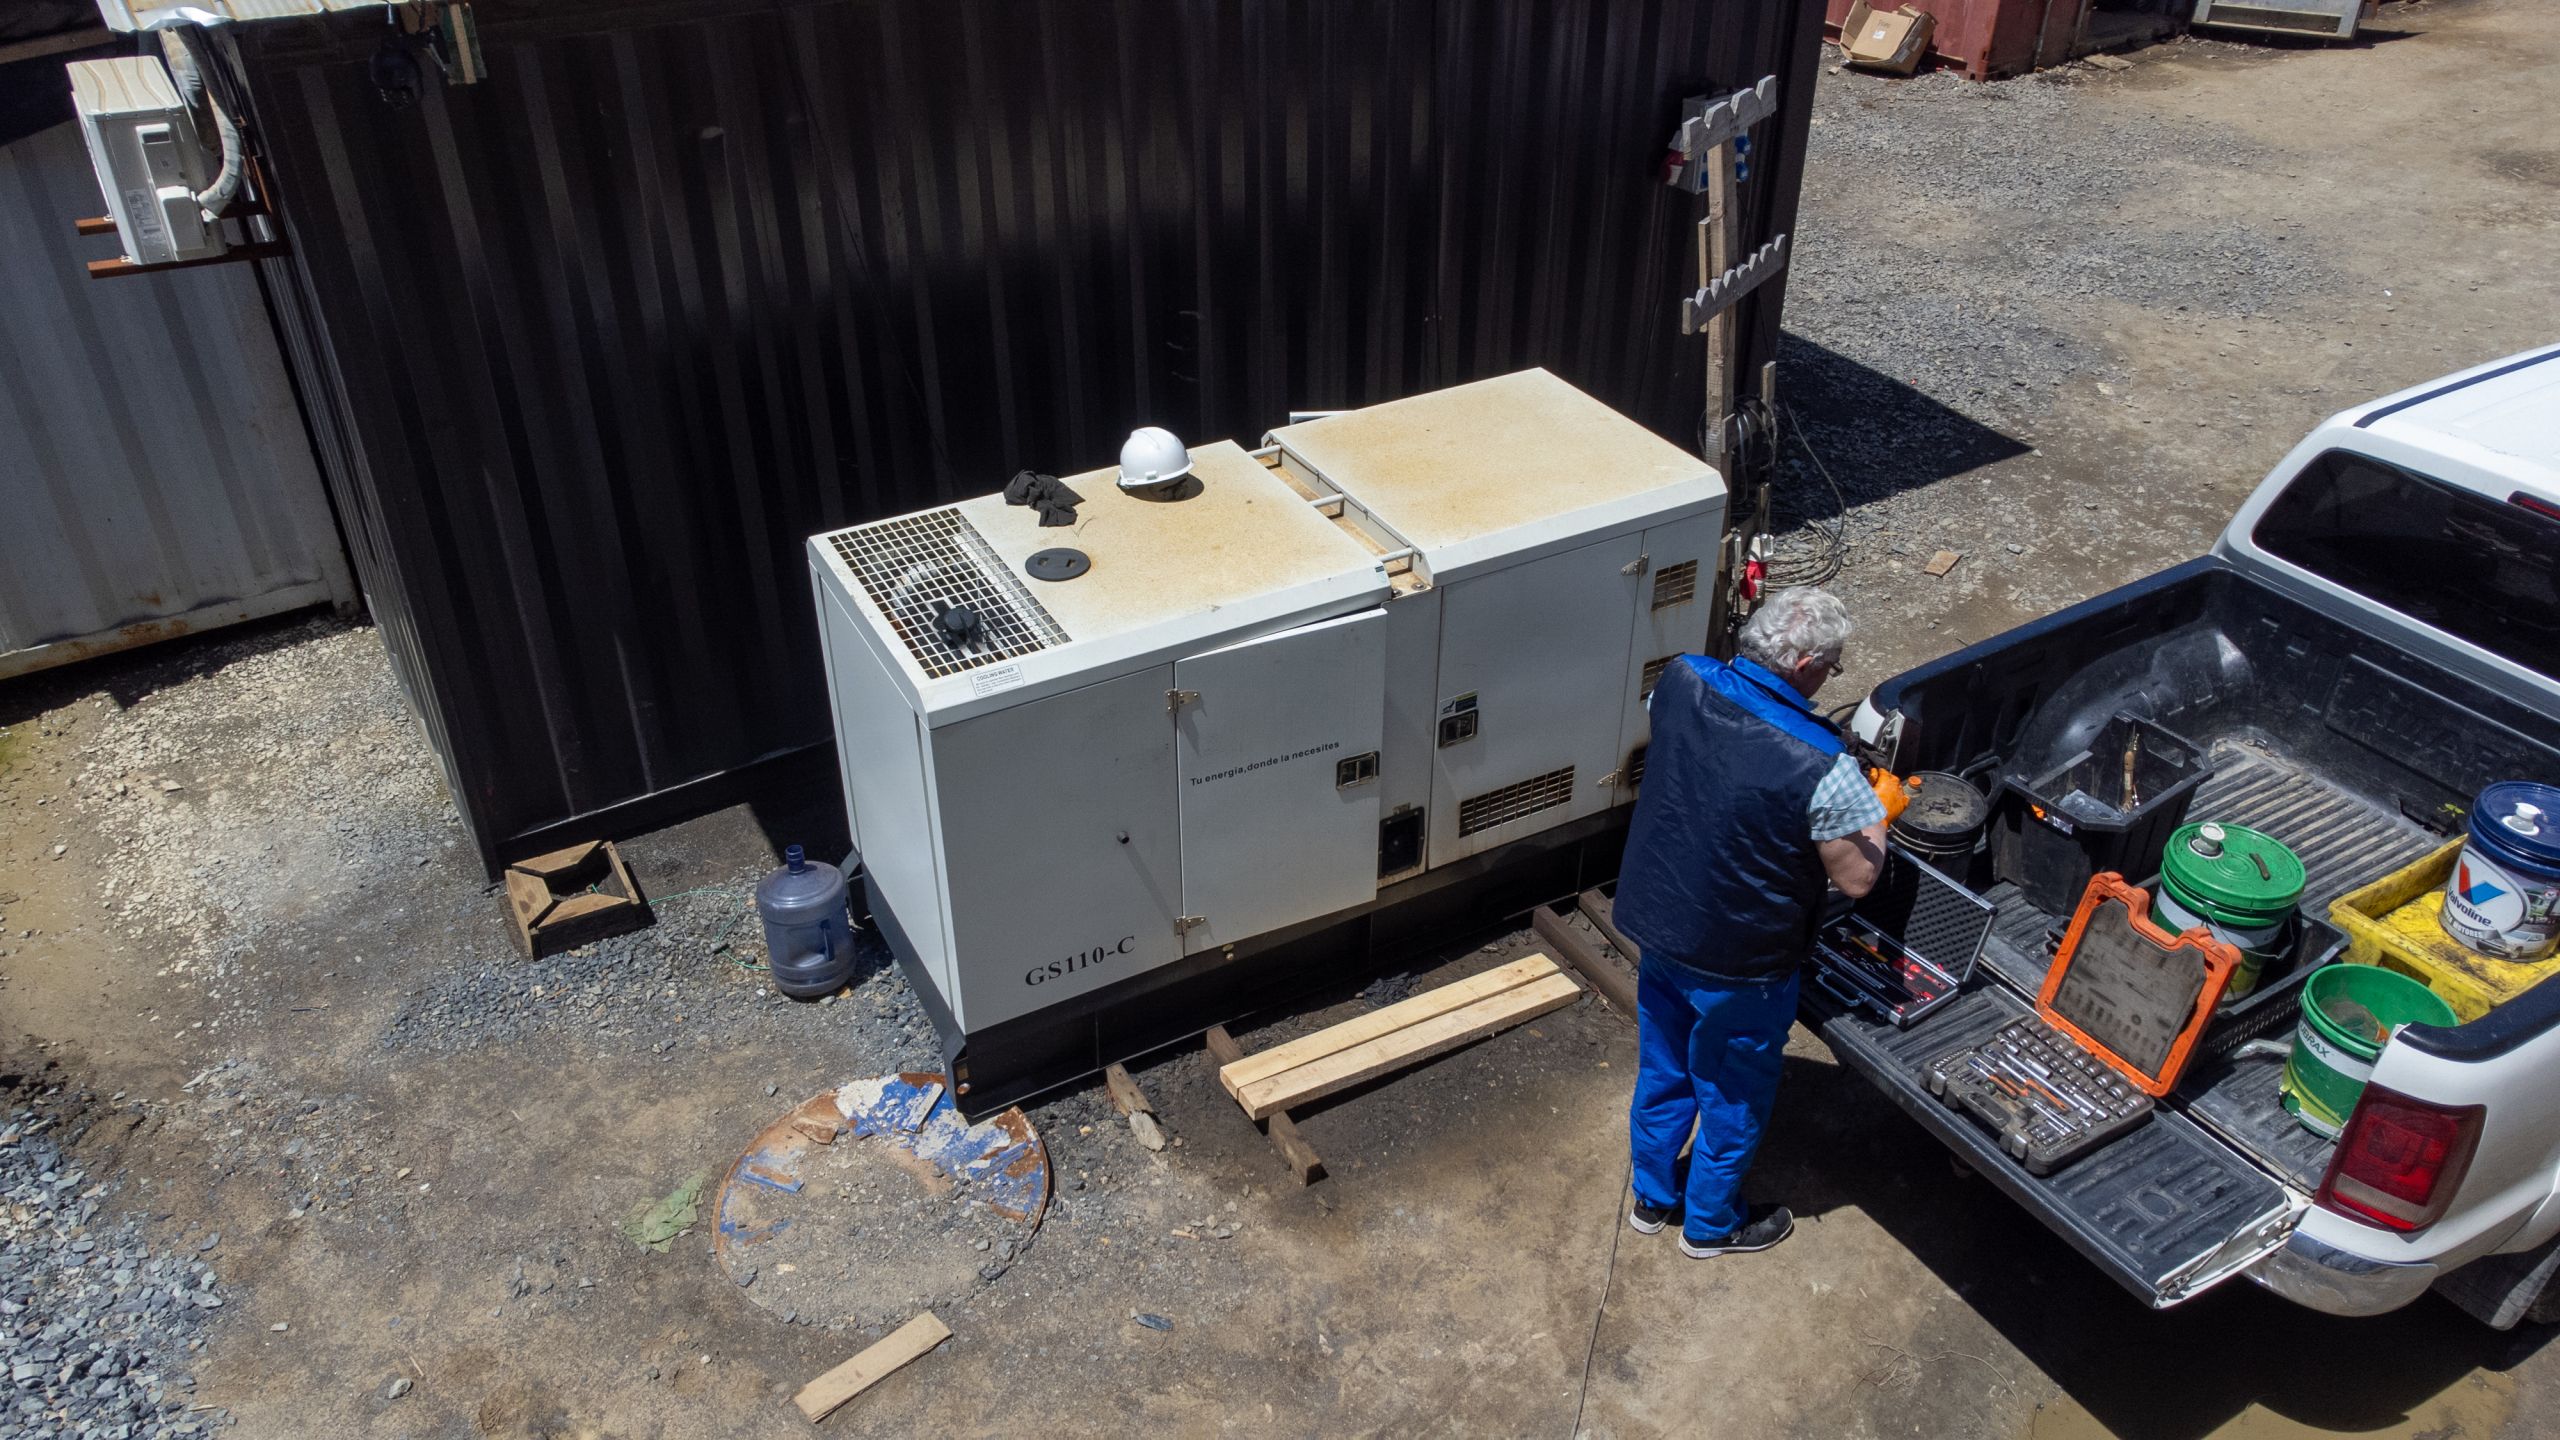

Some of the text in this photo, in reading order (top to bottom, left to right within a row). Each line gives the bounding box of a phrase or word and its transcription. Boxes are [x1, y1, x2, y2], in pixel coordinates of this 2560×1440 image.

[976, 667, 1014, 681] COOLING WATER
[1190, 777, 1203, 786] Tu
[1281, 754, 1290, 763] la
[1292, 741, 1340, 760] necesites
[2448, 886, 2492, 927] Valvoline
[1025, 935, 1136, 986] GS110-C
[2300, 1022, 2330, 1058] UBRAX
